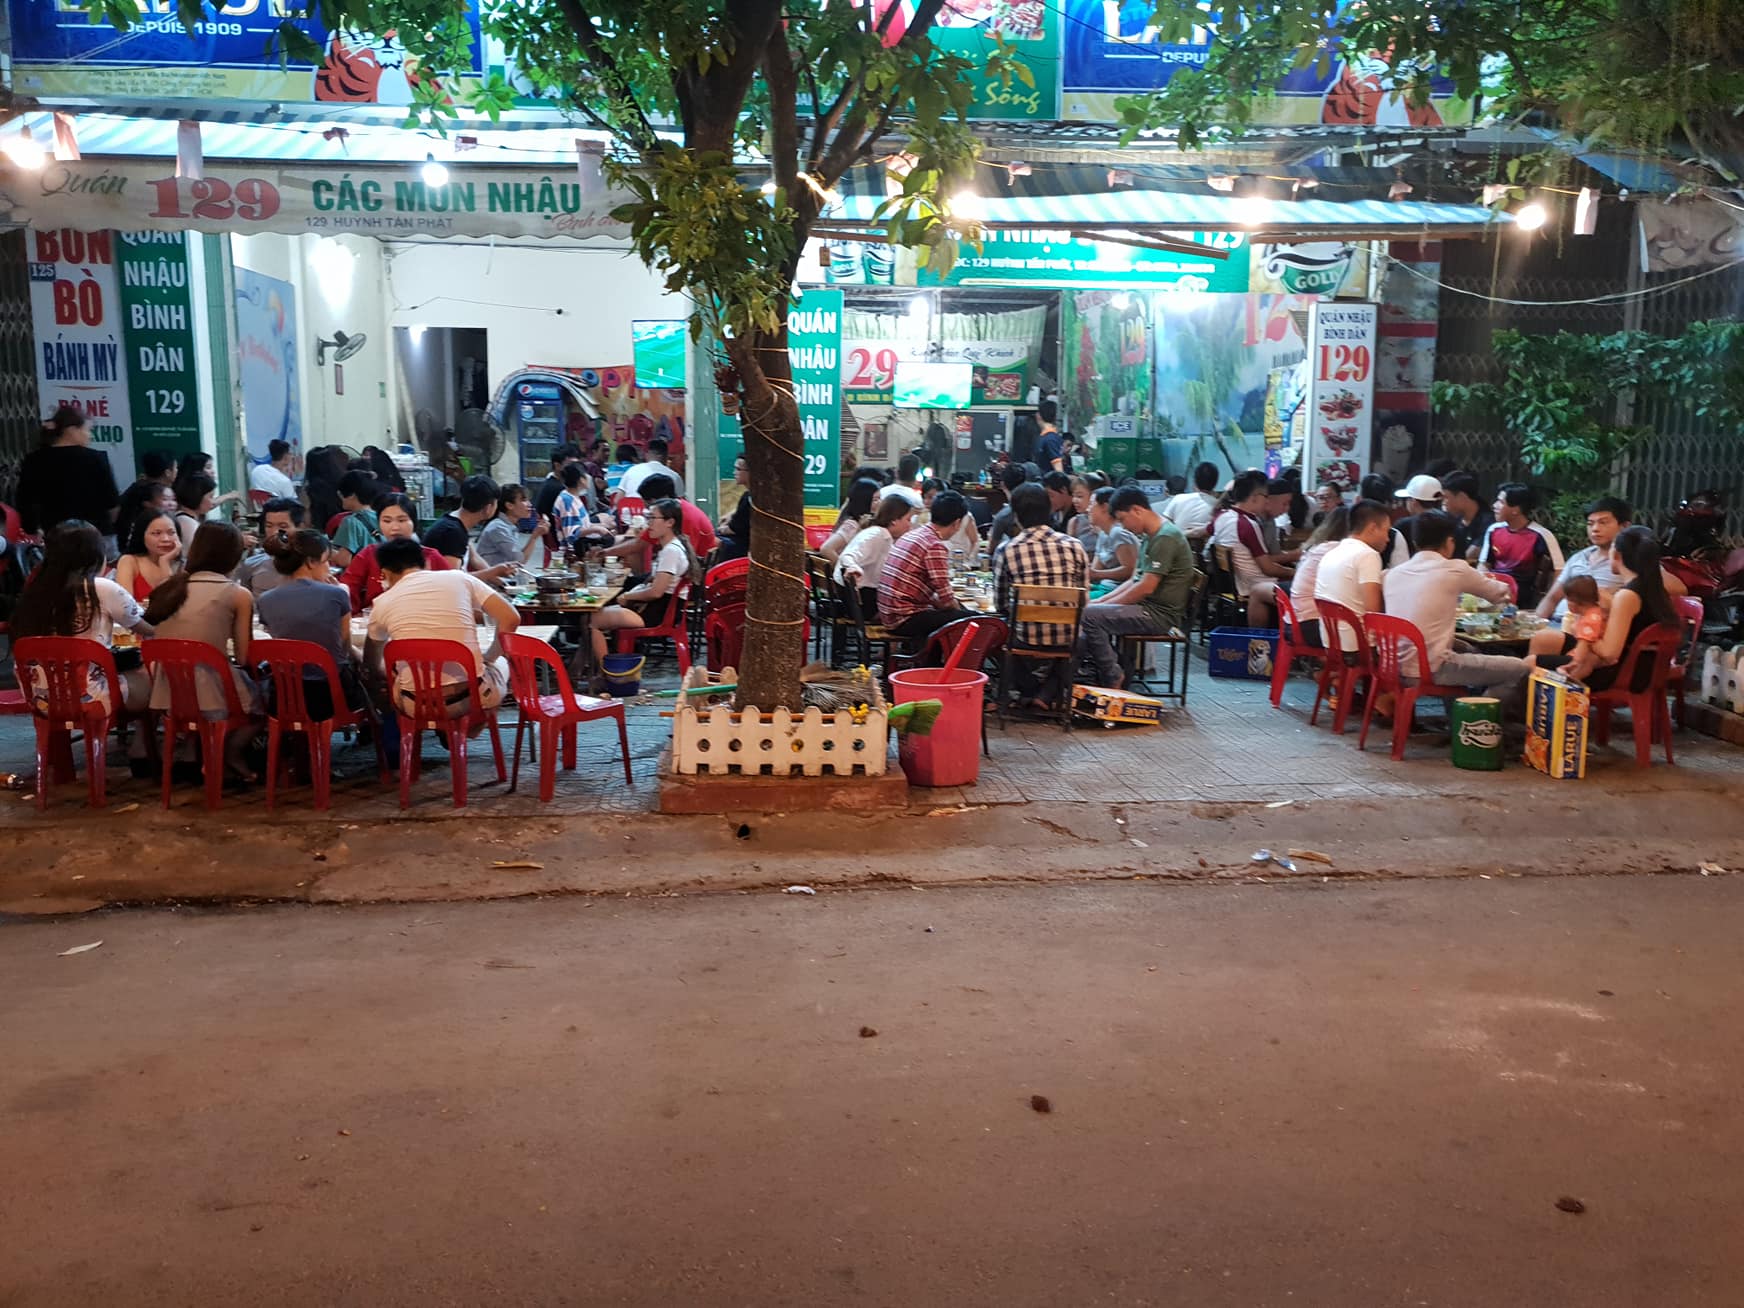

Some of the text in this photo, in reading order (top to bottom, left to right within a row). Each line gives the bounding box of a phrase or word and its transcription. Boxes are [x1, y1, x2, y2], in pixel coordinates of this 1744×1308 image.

[195, 22, 242, 36] 1909
[1162, 52, 1210, 63] DEPU
[40, 168, 129, 198] Quán
[312, 173, 383, 211] CÁC
[488, 176, 581, 220] NHẬU
[146, 176, 281, 222] 129
[306, 216, 328, 227] 129
[31, 264, 54, 277] 125
[124, 257, 185, 294] NHẬU
[54, 268, 103, 327] BÒ
[131, 299, 186, 330] BÌNH
[788, 307, 837, 335] QUÁN
[43, 333, 118, 381] BÁNH MỲ
[139, 341, 185, 372] DÂN
[789, 344, 836, 375] NHẬU
[848, 348, 898, 389] 29
[1318, 344, 1371, 382] 129
[87, 396, 109, 417] NÉ
[146, 390, 185, 414] 129
[91, 425, 123, 443] KHO
[803, 415, 829, 440] ÂN
[805, 455, 827, 475] 29
[1564, 721, 1577, 772] LARUE
